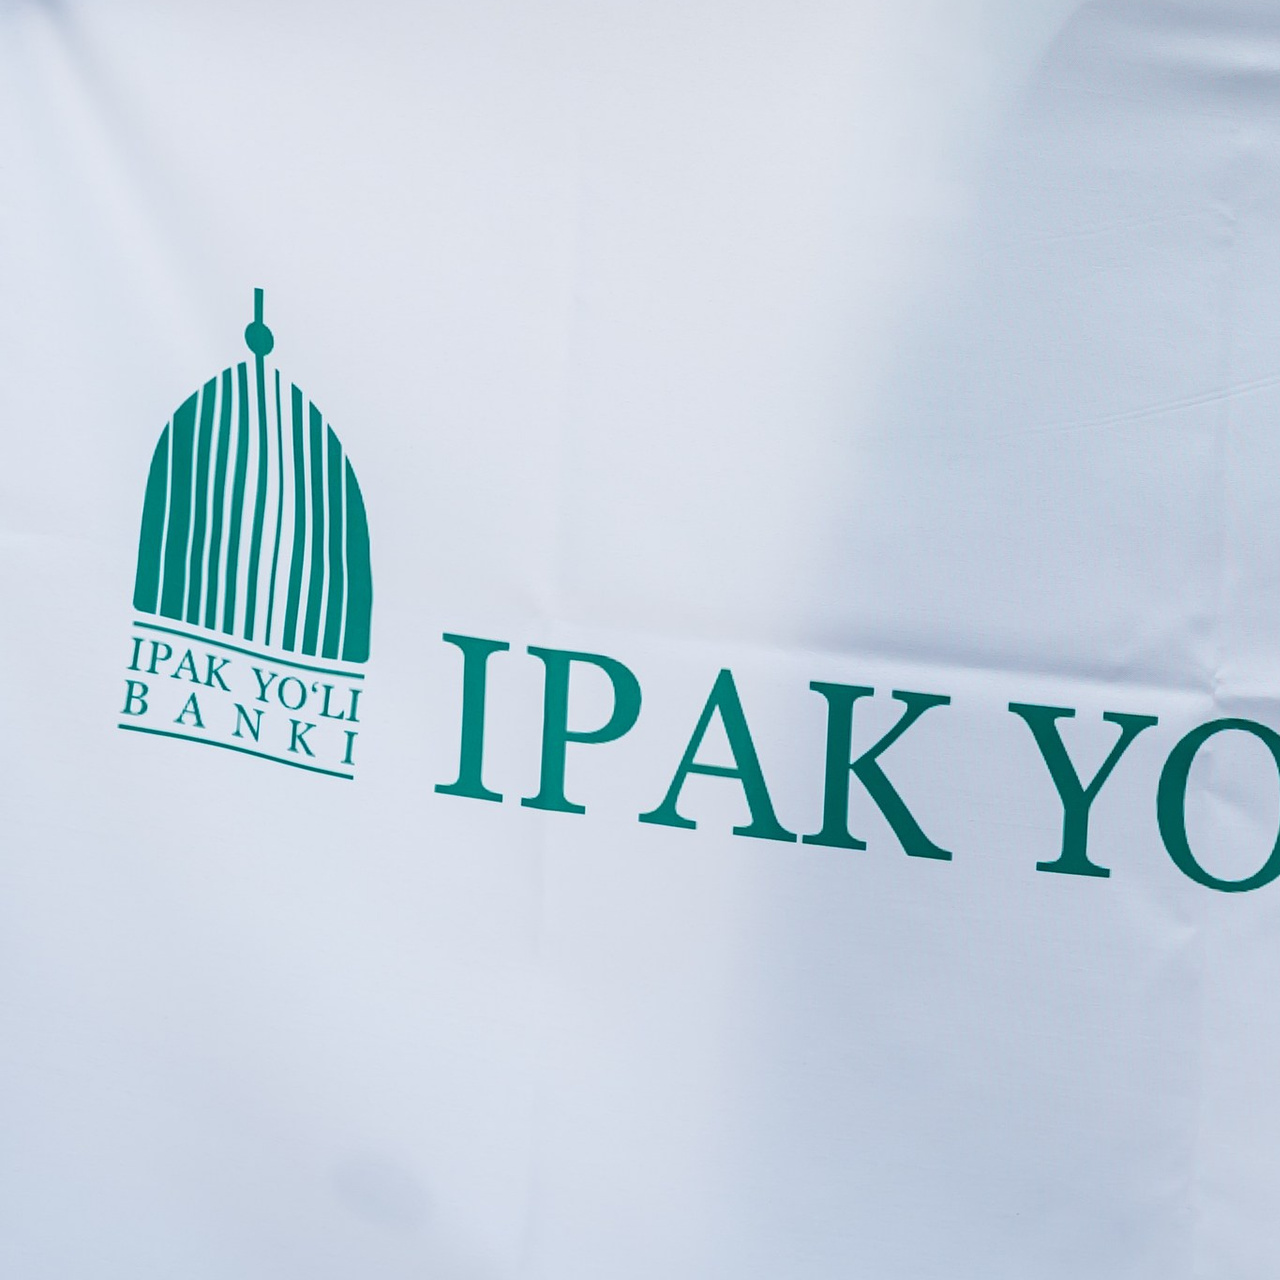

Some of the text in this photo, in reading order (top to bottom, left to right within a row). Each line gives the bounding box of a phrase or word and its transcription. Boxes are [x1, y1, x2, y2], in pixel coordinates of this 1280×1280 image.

[126, 636, 232, 692] IPAK
[120, 678, 359, 766] BANKI
[434, 631, 954, 862] IPAK
